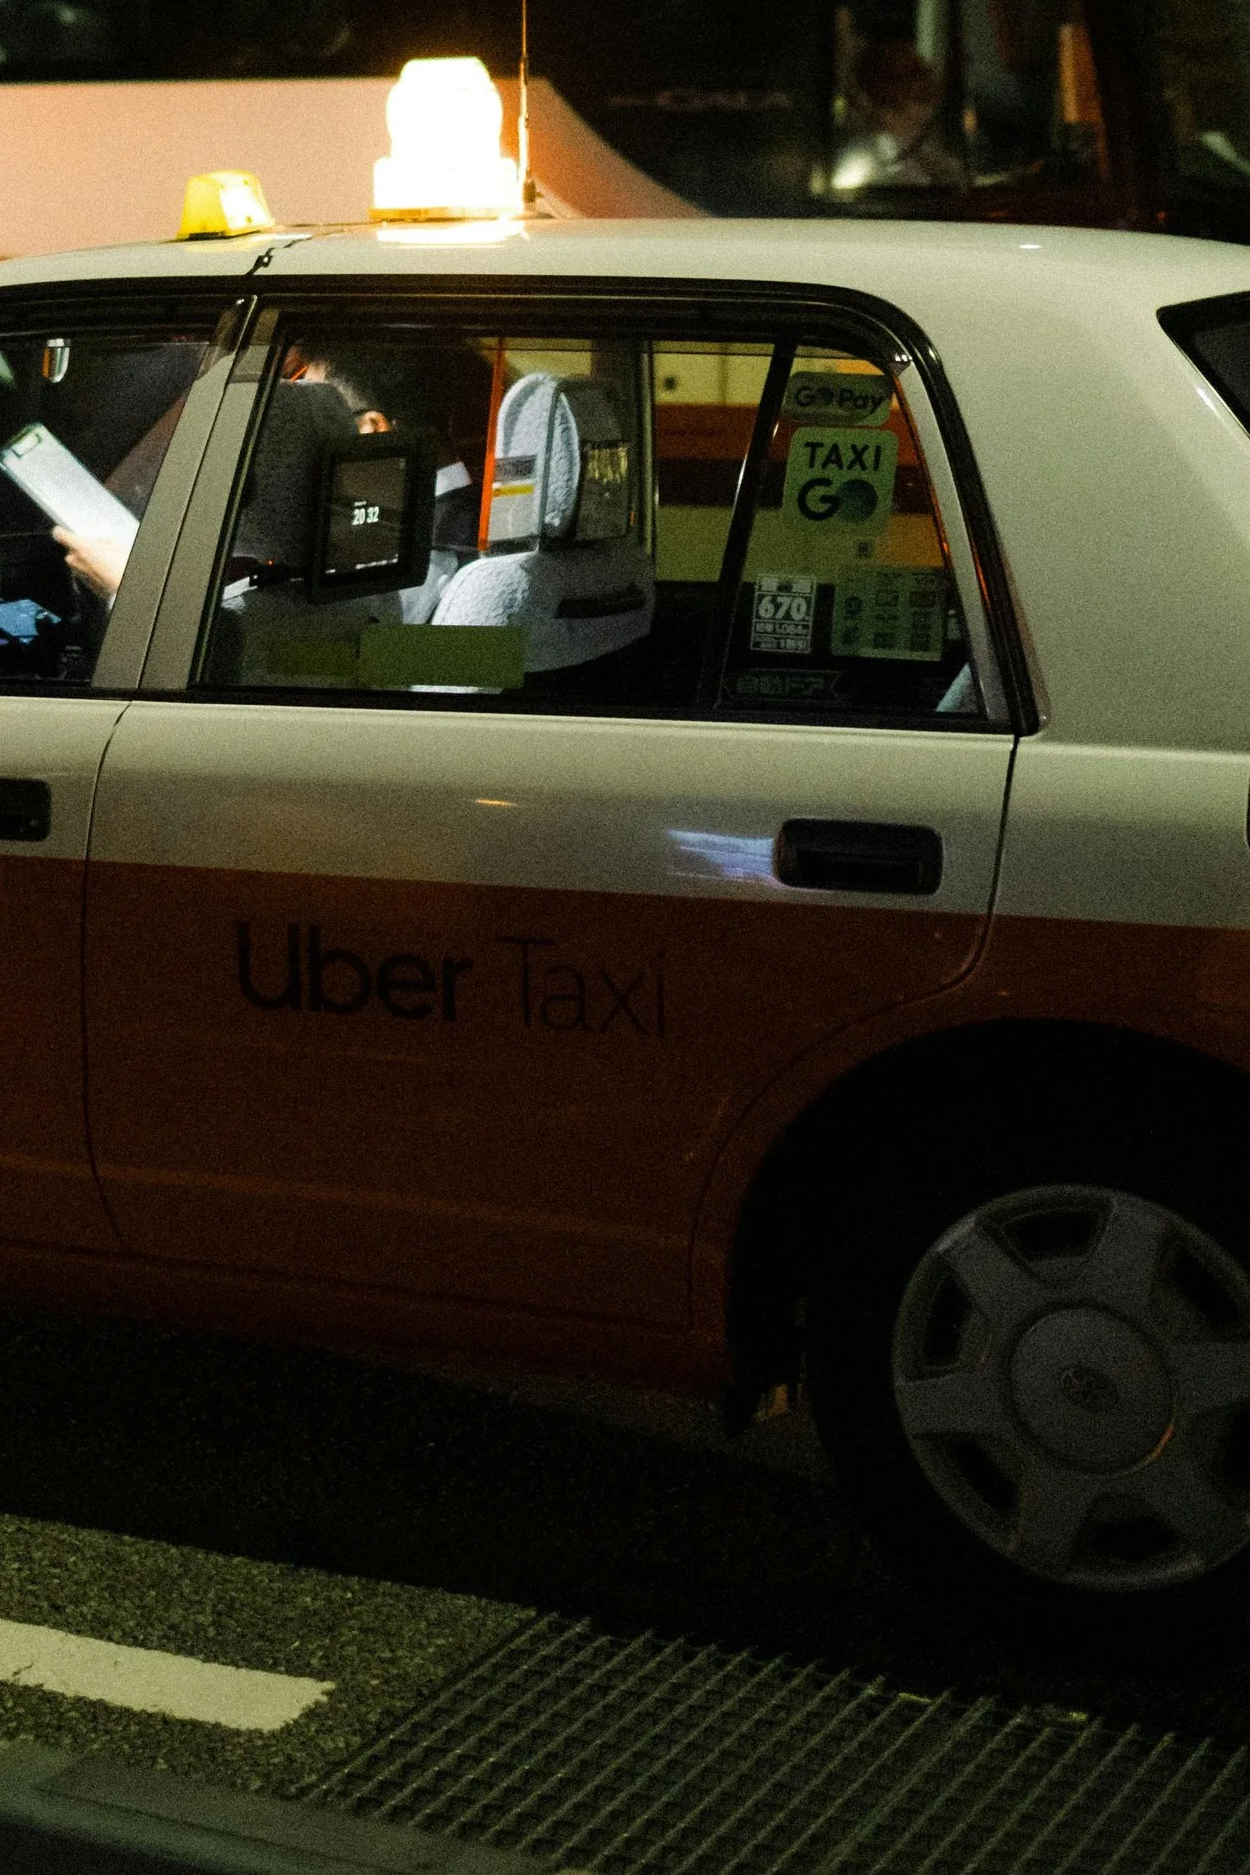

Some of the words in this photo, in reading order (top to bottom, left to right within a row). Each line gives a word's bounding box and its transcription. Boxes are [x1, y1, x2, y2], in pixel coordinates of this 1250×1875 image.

[838, 387, 885, 415] Pay
[803, 440, 883, 472] TAXI
[238, 921, 473, 1021] Uber
[497, 934, 668, 1037] Taxi
